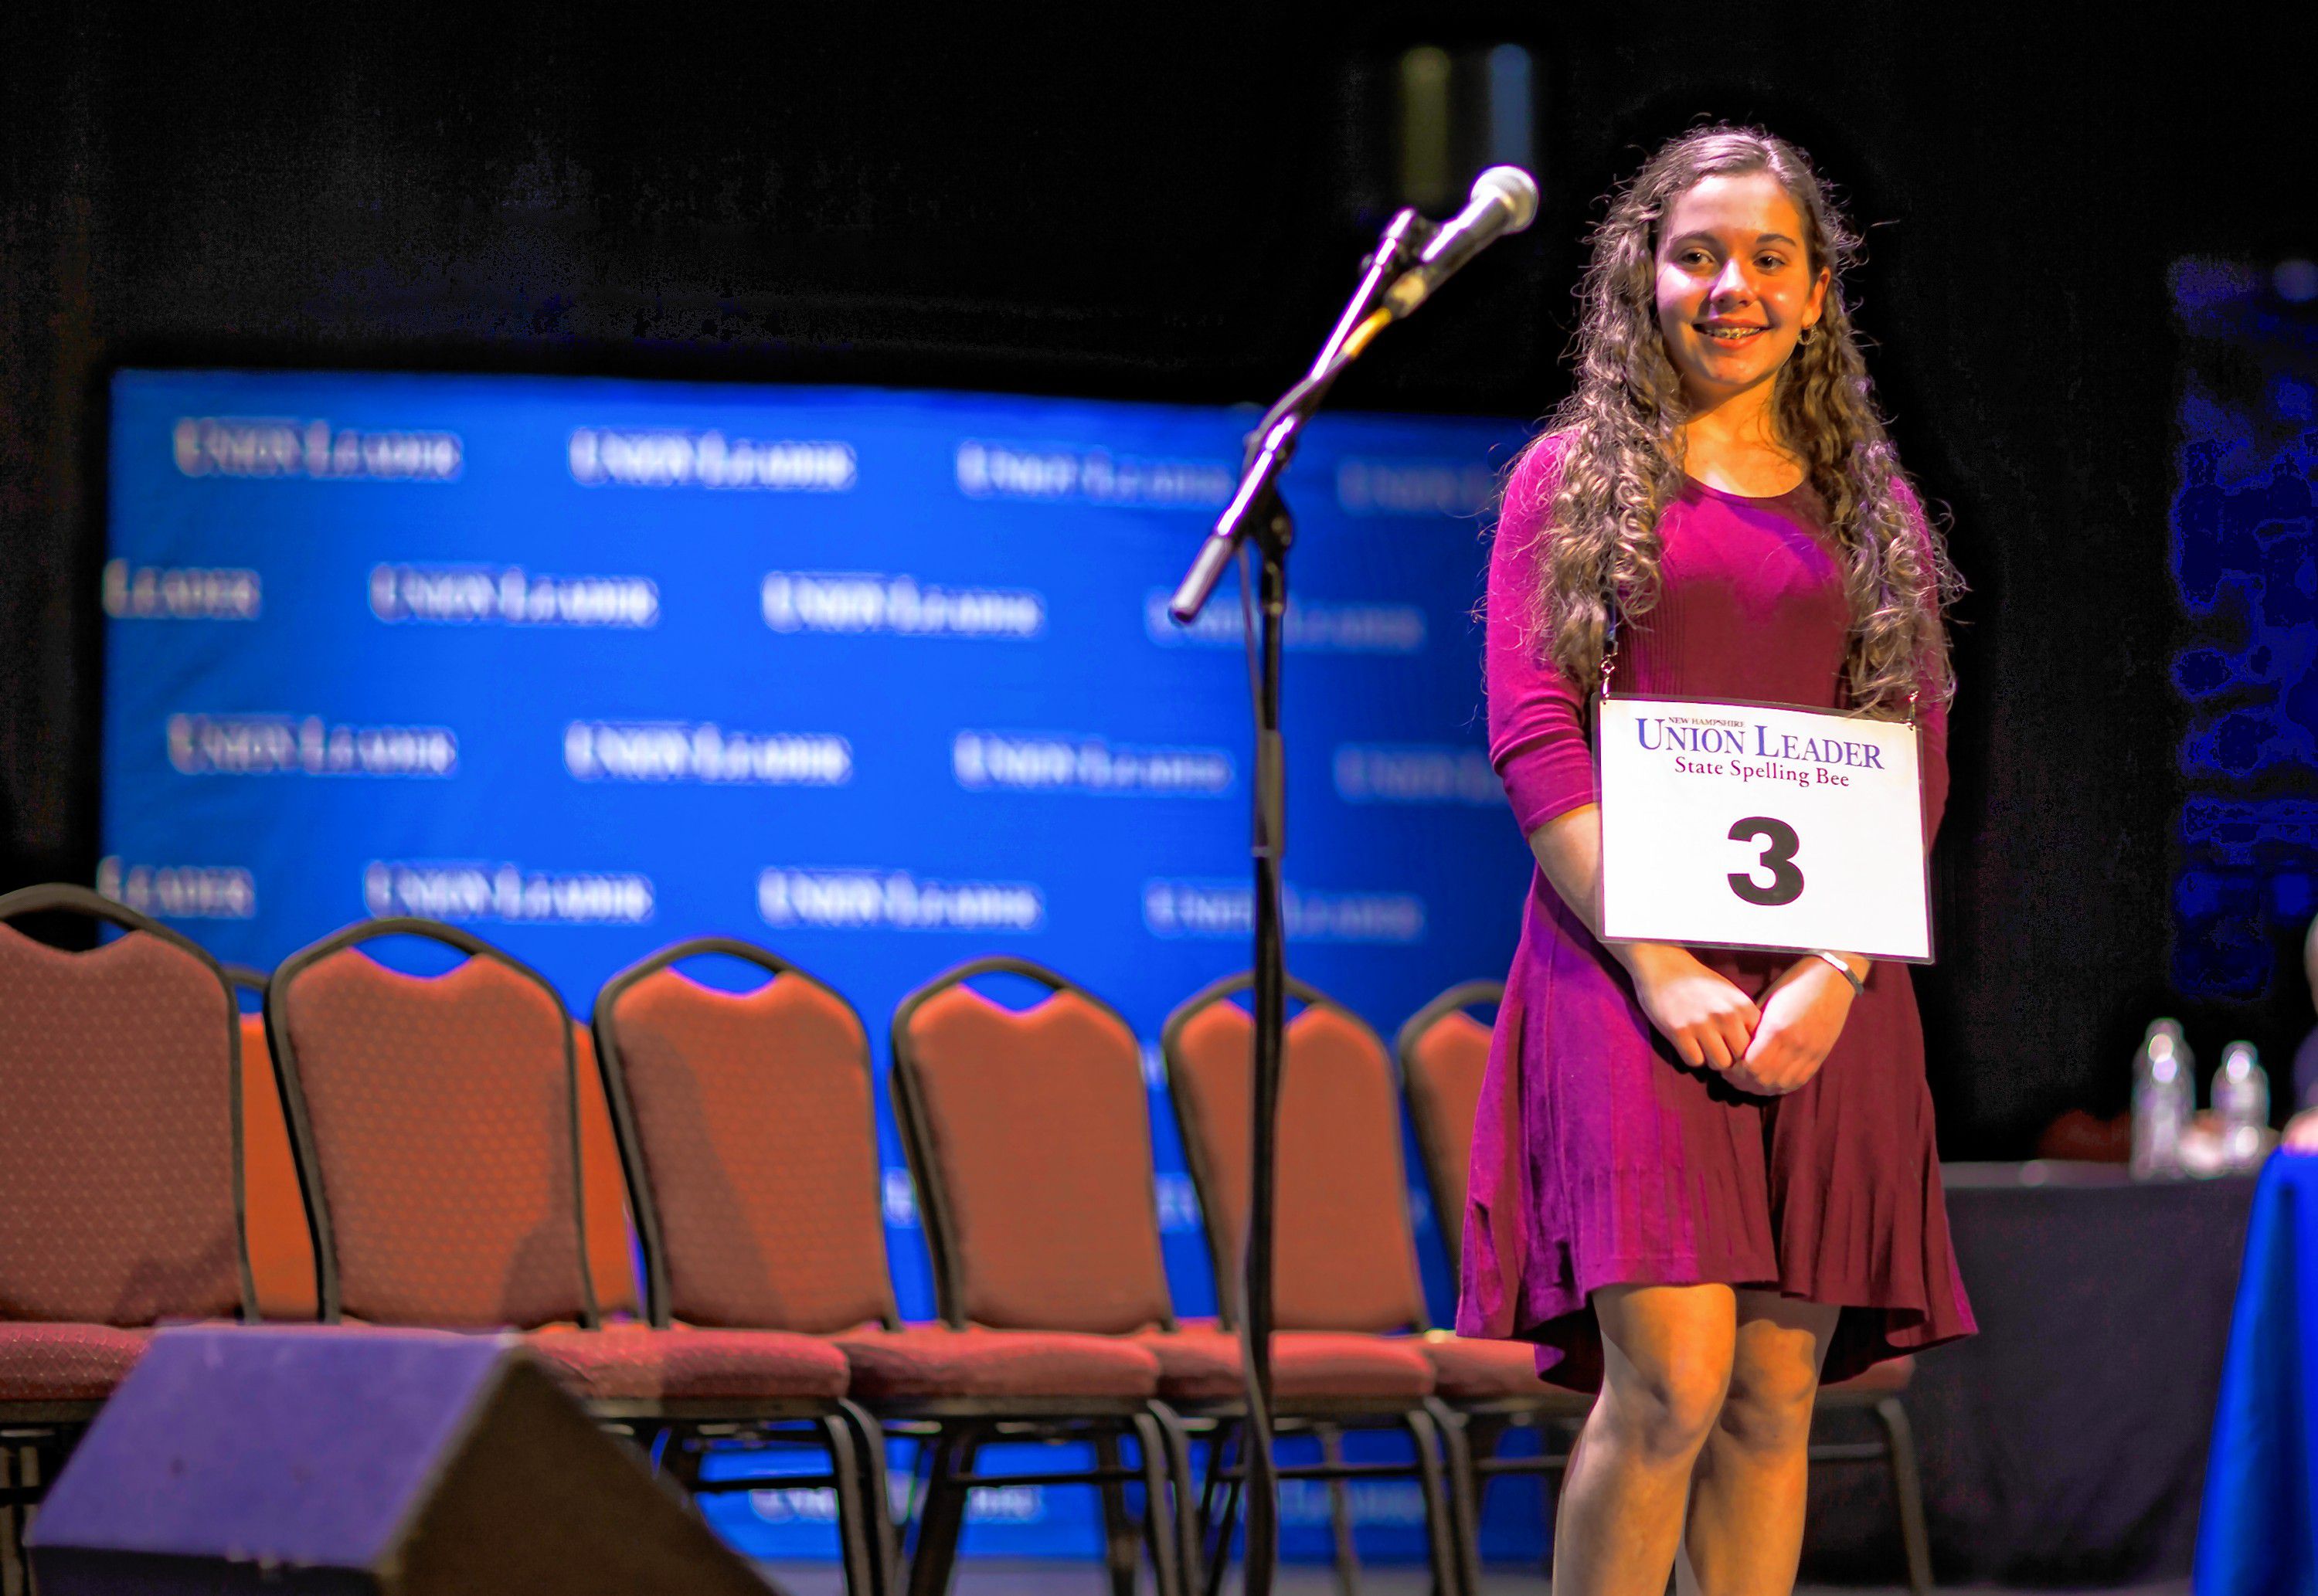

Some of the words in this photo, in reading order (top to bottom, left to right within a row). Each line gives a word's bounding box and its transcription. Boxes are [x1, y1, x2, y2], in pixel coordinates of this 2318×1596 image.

[1691, 717, 1745, 728] HAMPSHIRE
[1634, 718, 1745, 754] UNION
[1754, 725, 1885, 770] LEADER
[1675, 756, 1723, 775] State
[1729, 760, 1810, 788] Spelling
[1817, 768, 1850, 787] Bee
[1727, 816, 1805, 906] 3
